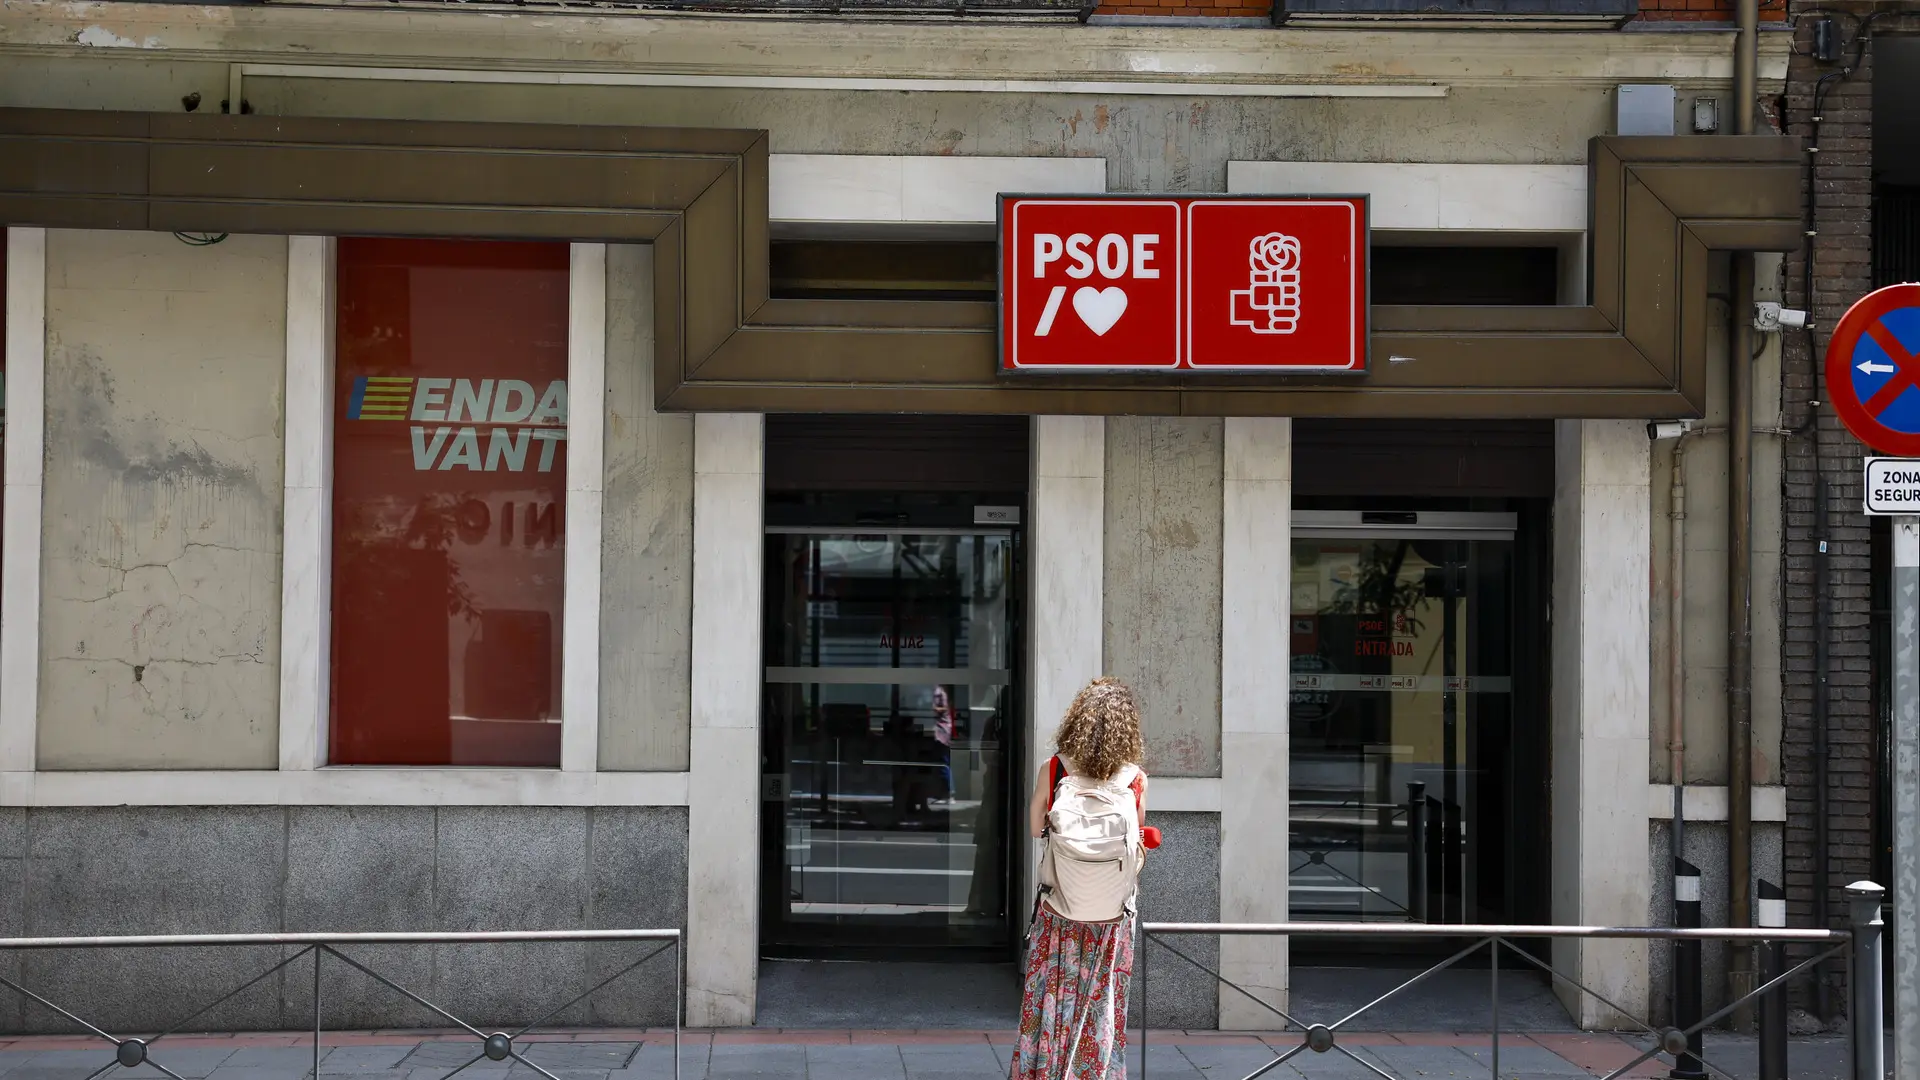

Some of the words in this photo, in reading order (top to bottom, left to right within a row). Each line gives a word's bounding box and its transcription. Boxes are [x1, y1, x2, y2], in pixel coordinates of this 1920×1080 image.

[1033, 233, 1160, 280] PSOE
[410, 377, 568, 424] ENDA
[410, 425, 568, 473] VANT
[1883, 471, 1920, 484] ZONA
[1874, 489, 1920, 502] SEGUR
[1357, 620, 1384, 631] PSOE
[1354, 639, 1414, 656] ENTRADA
